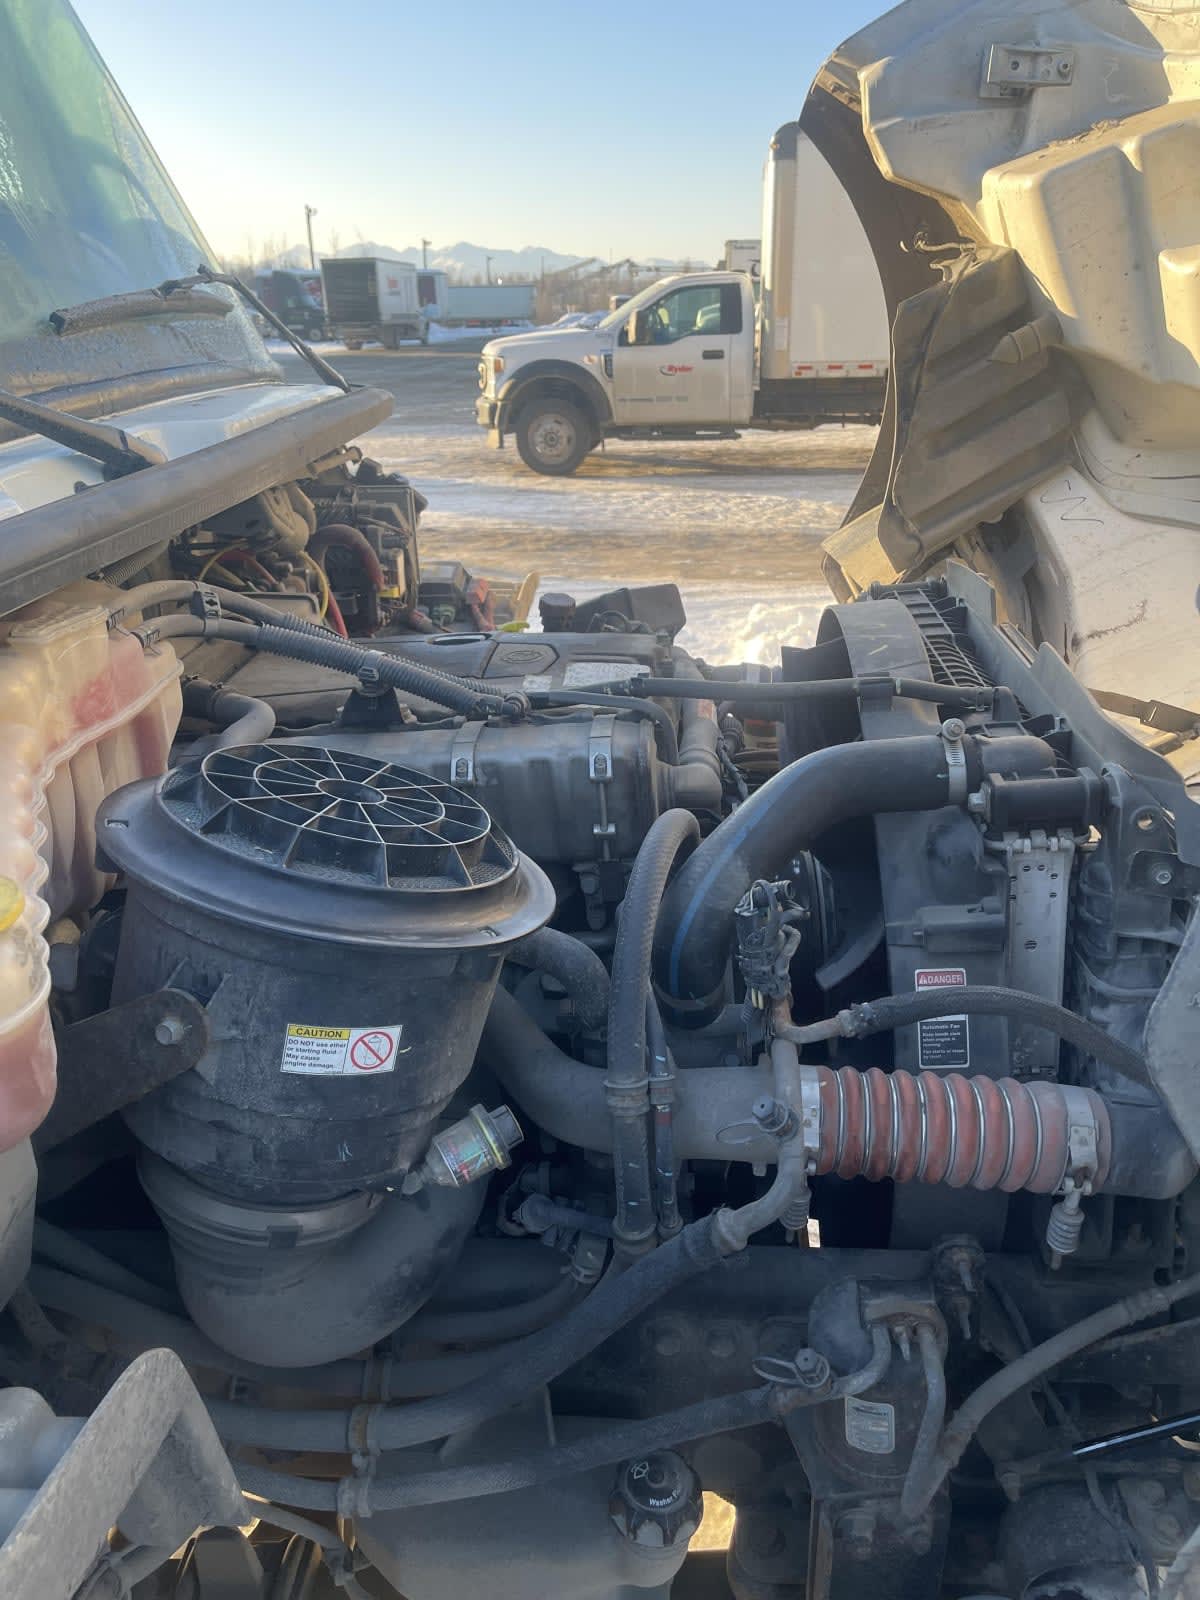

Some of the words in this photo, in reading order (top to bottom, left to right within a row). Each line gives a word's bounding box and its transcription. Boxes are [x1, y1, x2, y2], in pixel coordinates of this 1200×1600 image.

[927, 974, 963, 985] DANGER
[296, 1028, 342, 1038] CAUTION
[296, 1047, 320, 1055] starting
